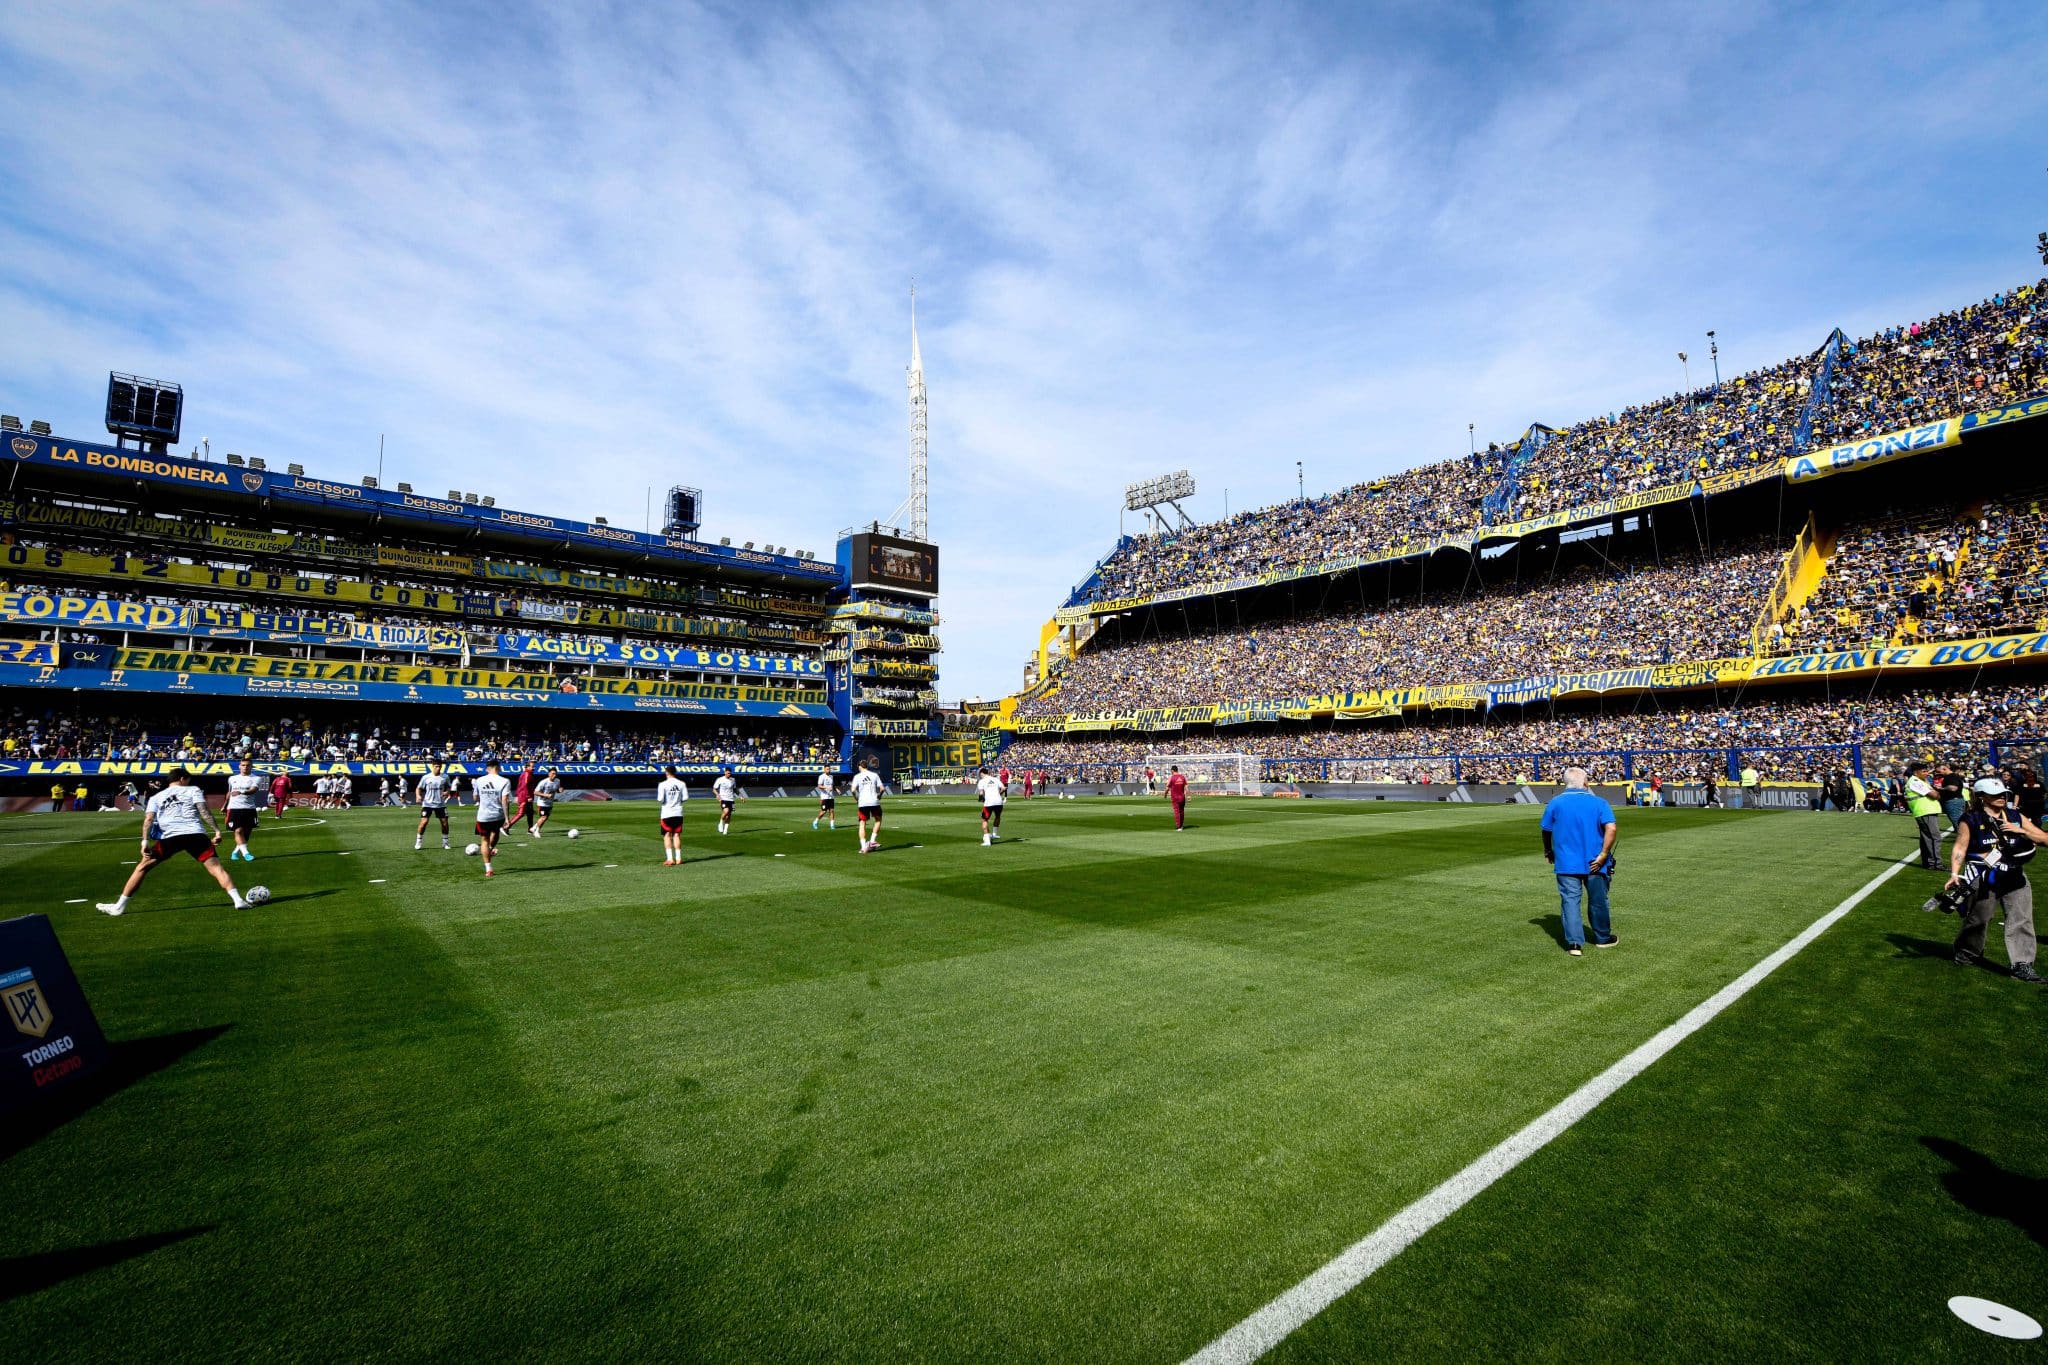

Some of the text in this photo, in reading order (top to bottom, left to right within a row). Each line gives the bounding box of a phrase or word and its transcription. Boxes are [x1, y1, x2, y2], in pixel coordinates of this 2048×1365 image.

[1831, 420, 1948, 469] BONZI
[51, 446, 229, 485] LA BOMBONERA
[294, 477, 361, 498] betsson
[1635, 482, 1691, 507] FERROVIARIA
[403, 495, 463, 513] betsson
[135, 516, 204, 540] POMPEYA
[500, 510, 554, 528] betsson
[226, 530, 277, 541] MOVIMIENTO
[588, 524, 636, 541] betsson
[223, 538, 243, 548] BOCA
[666, 537, 709, 553] betsson
[381, 551, 433, 565] QUINQUELA
[436, 557, 469, 569] MARTIN
[736, 548, 774, 563] betsson
[799, 558, 835, 573] betsson
[110, 556, 168, 577] 12
[207, 565, 338, 595] TODOS
[521, 601, 564, 616] NICO
[254, 613, 345, 633] BOCA
[353, 623, 428, 643] LA RIOJA
[748, 627, 795, 640] RIVADAVIA
[620, 644, 679, 662] SOY
[697, 651, 823, 673] BOSTERO
[1756, 634, 2048, 676] AGUANTE BOCA
[248, 677, 359, 691] betsson
[268, 660, 400, 682] ESTARE
[410, 669, 433, 685] A
[445, 671, 477, 686] TU
[646, 682, 738, 700] JUNIORS
[746, 687, 826, 704] QUERIDO
[1490, 676, 1555, 692] VICTORIA
[1559, 668, 1652, 693] SPEGAZZINI
[463, 689, 550, 702] DIRECTV
[1497, 685, 1548, 703] DIAMANTE
[1218, 696, 1309, 713] ANDERSON
[1019, 715, 1068, 725] LIBERTADOR
[1072, 709, 1136, 721] JOSE C PAZ
[879, 721, 926, 733] VARELA
[893, 745, 977, 768] BUDGE
[28, 761, 234, 775] LA NUEVA
[309, 763, 352, 774] LA
[613, 765, 659, 773] BOCA
[734, 765, 789, 773] flecha
[22, 1035, 75, 1068] TORNEO
[32, 1055, 83, 1088] Betano
